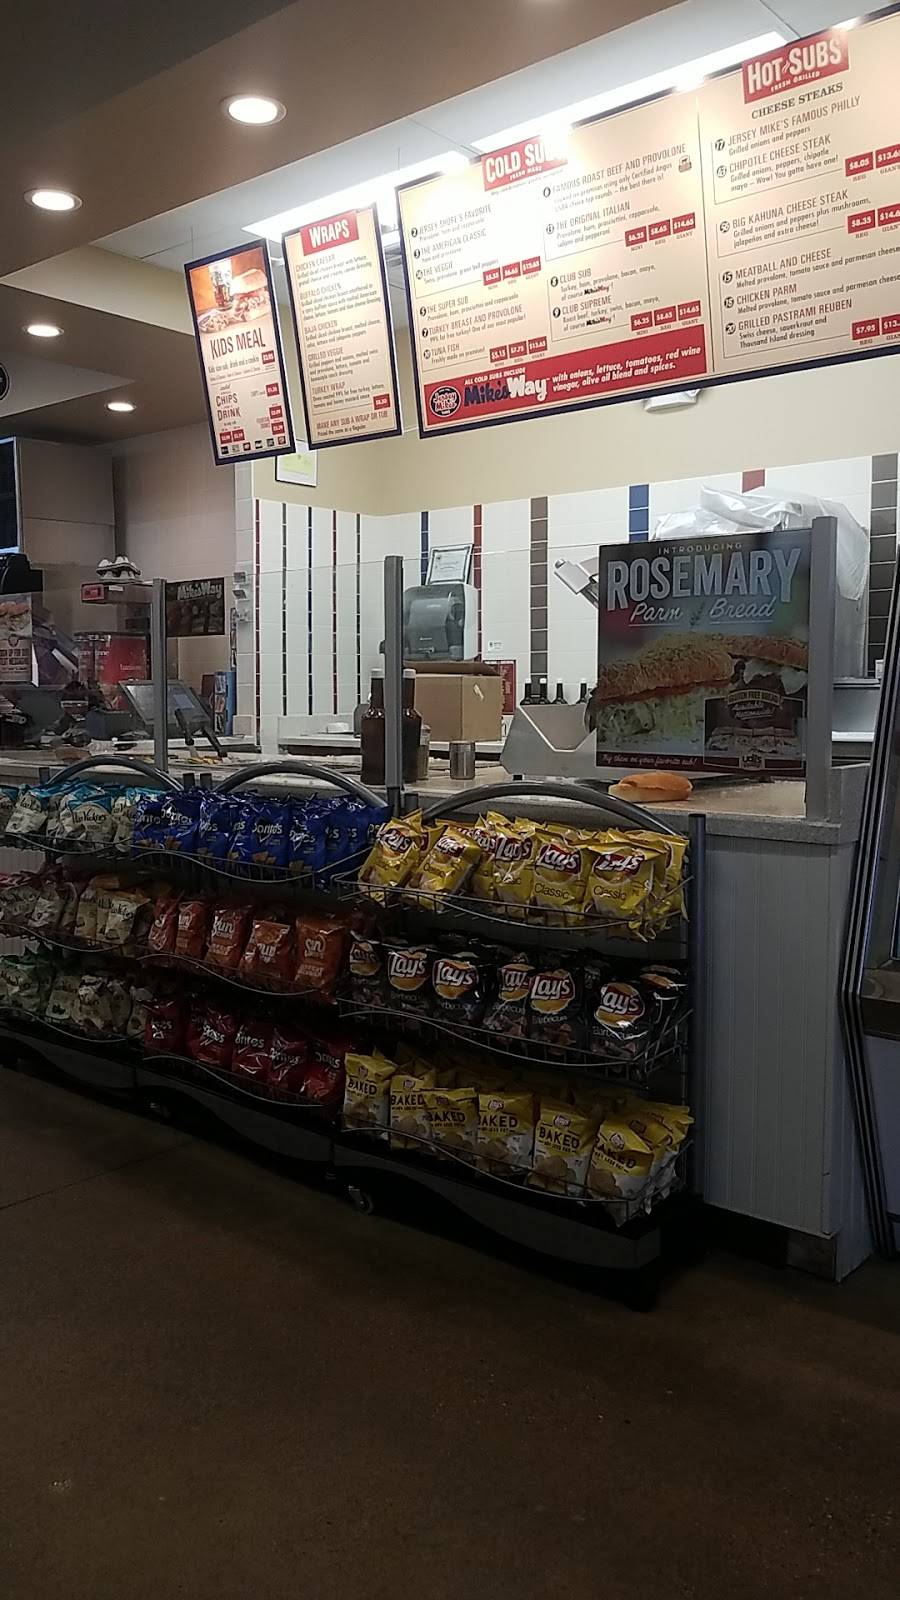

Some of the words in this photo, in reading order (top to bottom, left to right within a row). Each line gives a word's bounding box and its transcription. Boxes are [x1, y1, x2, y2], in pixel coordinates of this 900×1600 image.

[747, 57, 783, 94] HOT
[788, 39, 842, 76] SUBS
[771, 79, 791, 93] FRESH
[792, 71, 820, 84] GRILLED
[751, 100, 796, 120] CHEESE
[798, 82, 843, 104] STEAKS
[728, 128, 756, 146] JERSEY
[760, 118, 788, 136] MIKE'S
[792, 107, 828, 126] FAMOUS
[830, 96, 861, 116] PHILLY
[729, 142, 749, 156] Grilled
[750, 138, 771, 148] onions
[772, 134, 784, 145] and
[785, 126, 811, 142] peppers
[729, 154, 767, 173] CHIPOTLE
[770, 144, 800, 164] CHEESE
[802, 134, 832, 152] STEAK
[485, 151, 521, 183] COLD
[582, 168, 604, 184] ROAST
[606, 163, 622, 178] BEEF
[624, 158, 641, 171] AND
[642, 144, 686, 166] PROVOLONE
[632, 166, 654, 182] Certified
[655, 162, 672, 177] Angus
[730, 170, 750, 183] Grilled
[803, 148, 830, 164] chipotle
[730, 182, 748, 194] mayo
[756, 175, 773, 186] Wow!
[774, 172, 786, 182] You
[787, 166, 804, 180] gotta
[806, 160, 822, 173] have
[824, 154, 839, 168] one!
[570, 210, 601, 228] ORIGINAL
[602, 201, 630, 218] ITALIAN
[732, 215, 746, 228] BIG
[748, 206, 784, 225] KAHUNA
[786, 197, 818, 215] CHEESE
[820, 188, 848, 206] STEAK
[734, 225, 754, 238] Grilled
[754, 222, 775, 232] onions
[776, 216, 788, 227] and
[790, 210, 815, 226] peppers
[816, 206, 830, 220] plus
[831, 196, 871, 213] mushrooms,
[308, 219, 351, 249] WRAPS
[764, 229, 776, 241] and
[777, 226, 794, 238] extra
[796, 220, 820, 233] cheese!
[559, 272, 576, 284] CLUB
[578, 266, 592, 280] SUB
[736, 261, 776, 280] MEATBALL
[780, 256, 798, 270] AND
[800, 248, 832, 265] CHEESE
[736, 276, 756, 289] Melted
[756, 272, 788, 286] provolone,
[789, 266, 810, 277] tomato
[812, 262, 830, 273] sauce
[831, 257, 843, 268] and
[844, 250, 876, 267] parmesan
[438, 299, 456, 312] SUPER
[457, 295, 469, 306] SUB
[562, 302, 579, 315] CLUB
[580, 295, 612, 311] SUPREME
[736, 289, 770, 306] CHICKEN
[772, 283, 797, 298] PARM
[738, 302, 758, 315] Melted
[758, 298, 789, 312] provolone,
[790, 292, 812, 303] tomato
[814, 288, 832, 299] sauce
[832, 282, 844, 294] and
[846, 276, 878, 292] parmesan
[429, 324, 449, 336] TURKEY
[451, 316, 472, 330] BREAST
[474, 312, 487, 324] AND
[488, 304, 523, 321] PROVOLONE
[738, 316, 770, 332] GRILLED
[772, 305, 817, 324] PASTRAMI
[819, 298, 852, 315] REUBEN
[740, 329, 754, 342] Swiss
[756, 326, 778, 338] cheese,
[780, 318, 814, 334] sauerkraut
[815, 316, 828, 326] and
[740, 336, 768, 349] Thousand
[769, 333, 788, 344] Island
[789, 328, 815, 342] dressing
[210, 336, 234, 360] KIDS
[235, 328, 266, 352] MEAL
[431, 346, 446, 356] TUNA
[447, 343, 460, 352] FISH
[474, 376, 489, 385] COLD
[489, 372, 502, 381] SUBS
[504, 366, 526, 378] INCLUDE
[552, 372, 568, 383] with
[570, 367, 594, 378] onions,
[596, 362, 623, 374] lettuce,
[625, 354, 664, 370] tomatoes,
[666, 348, 680, 360] red
[681, 346, 701, 358] wine
[552, 380, 580, 393] vinegar,
[582, 376, 599, 388] olive
[601, 372, 610, 384] oil
[612, 368, 632, 381] blend
[634, 364, 648, 376] and
[650, 361, 676, 374] spices.
[330, 382, 346, 391] WRAP
[434, 390, 456, 402] Jersey
[215, 393, 238, 408] CHIPS
[217, 406, 241, 422] DRINK
[658, 542, 743, 555] INTRODUCING
[606, 546, 802, 612] ROSEMARY
[630, 602, 683, 621] Parm
[710, 596, 777, 619] Bread
[534, 882, 570, 900] Classic
[594, 885, 626, 900] Classic
[347, 1078, 376, 1095] BAKED
[390, 1093, 424, 1107] BAKED
[426, 1111, 466, 1124] BAKED
[538, 1126, 580, 1150] BAKED
